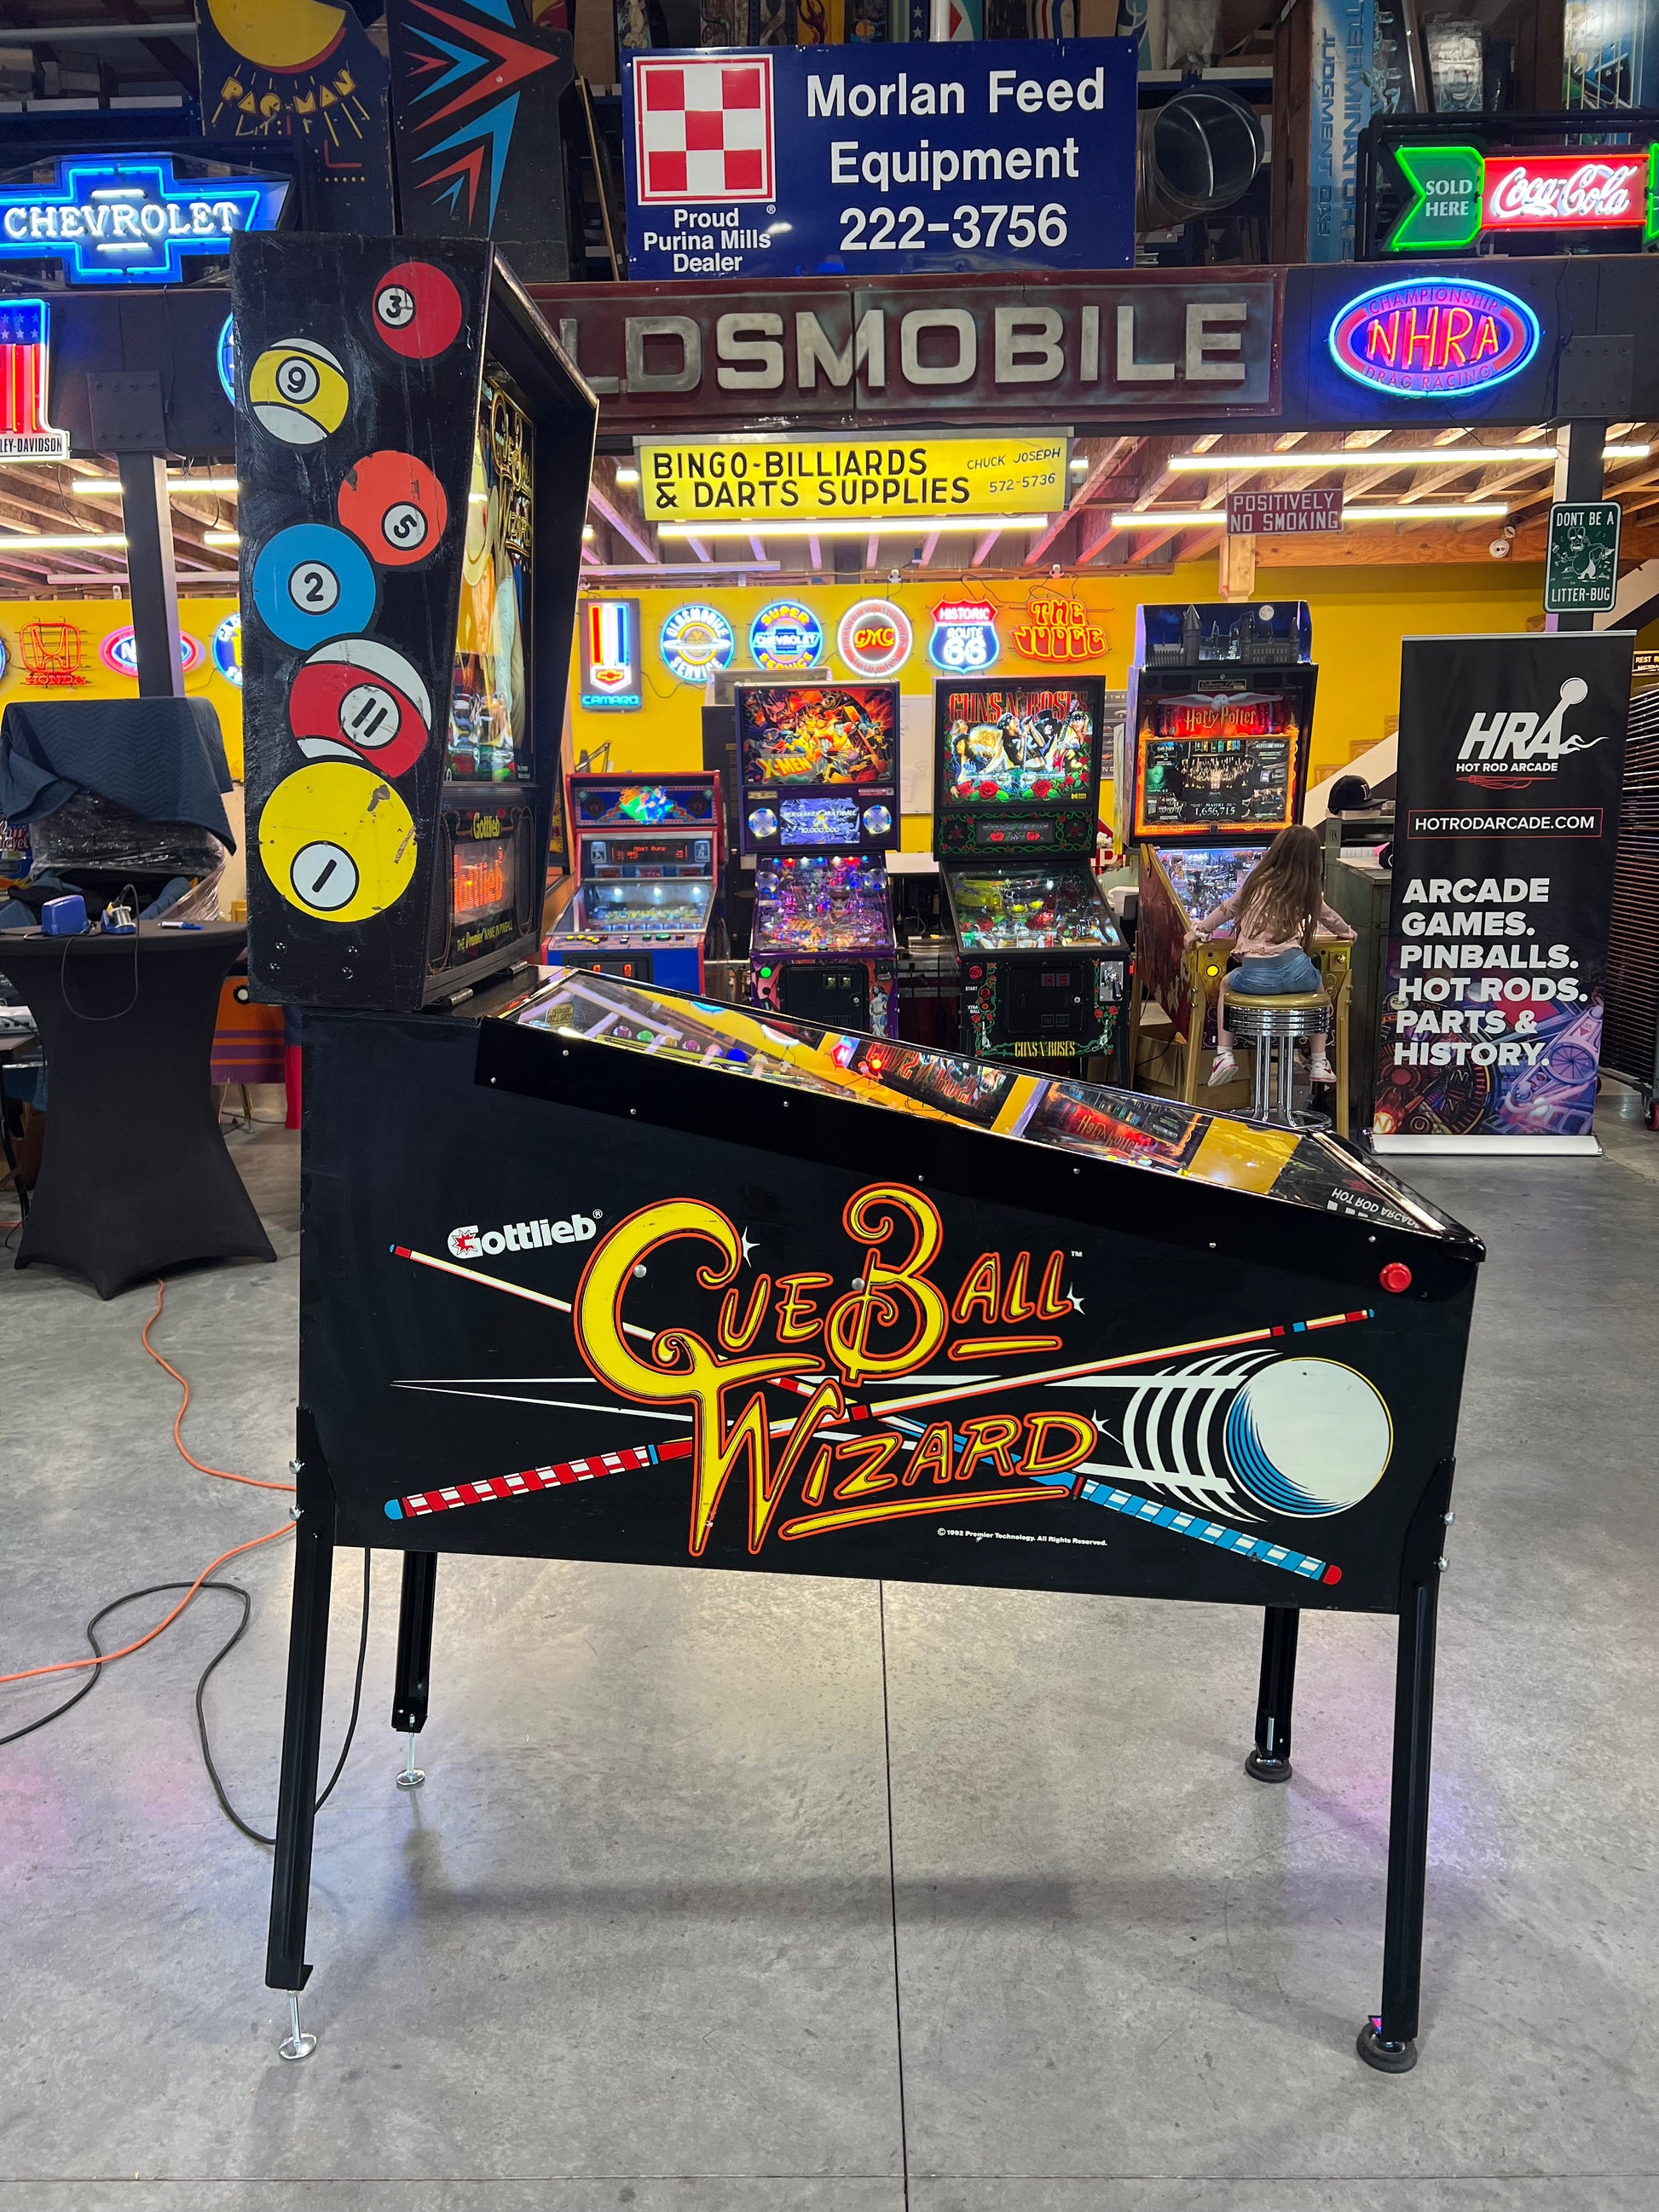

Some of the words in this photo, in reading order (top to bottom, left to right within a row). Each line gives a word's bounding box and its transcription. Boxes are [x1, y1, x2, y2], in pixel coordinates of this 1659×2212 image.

[806, 73, 965, 118] Morlan
[989, 66, 1106, 113] Feed
[1321, 27, 1336, 177] JUDGMENT
[830, 136, 1080, 192] Equipment
[1425, 180, 1472, 195] SOLD
[1491, 165, 1638, 217] Coca-Cola
[3, 201, 240, 239] CHEVROLET
[673, 208, 740, 228] Proud
[1317, 183, 1332, 237] DAY
[1425, 201, 1468, 217] HERE
[839, 203, 1069, 251] 222-3756
[643, 231, 714, 252] Purina
[720, 229, 772, 250] Mills
[673, 251, 743, 273] Dealer
[385, 295, 402, 320] 3
[1368, 288, 1499, 315] CHAMPIONSHIP
[559, 303, 1247, 395] LDSMOBILE
[1367, 307, 1499, 371] NHRA
[286, 360, 305, 391] 9
[1365, 367, 1413, 390] DRAG
[1422, 365, 1491, 390] RACING
[653, 448, 928, 479] BINGO-BILLIARDS
[967, 453, 1006, 470] CHUCK
[1012, 448, 1061, 467] JOSEPH
[656, 486, 679, 509] &
[695, 480, 799, 508] DARTS
[820, 477, 970, 505] SUPPLIES
[989, 473, 1055, 494] 572-5736
[1233, 492, 1335, 512] POSITIVELY
[394, 516, 417, 538] 5
[1230, 515, 1255, 532] NO
[1262, 511, 1338, 531] SMOKING
[1589, 512, 1602, 525] BE
[1607, 511, 1615, 525] A
[304, 572, 324, 602] 2
[1552, 587, 1610, 603] LITTER-BUG
[666, 607, 729, 637] OLDSMOBILE
[760, 605, 810, 626] SUPER
[939, 606, 991, 621] HISTORIC
[1031, 599, 1087, 627] THE
[755, 634, 818, 646] CHEVROLET
[854, 627, 895, 649] GMC
[946, 626, 985, 639] ROUTE
[1013, 626, 1107, 658] JUDGE
[943, 638, 987, 665] 66
[1635, 656, 1651, 664] REST
[25, 675, 86, 686] HONDA
[581, 695, 640, 706] CAMARO
[950, 691, 1003, 724] GUNS
[1026, 690, 1089, 723] ROSES
[350, 696, 388, 737] 11
[1183, 708, 1219, 732] Harry
[1221, 705, 1257, 730] Potter
[1457, 711, 1562, 760] HRA
[757, 757, 812, 781] X-MEN
[1456, 763, 1480, 772] HOT
[1483, 762, 1508, 772] ROD
[1510, 762, 1558, 772] ARCADE
[1194, 806, 1236, 817] 1,656,715
[1414, 815, 1595, 832] HOTRODARCADE.COM
[472, 812, 500, 840] Gottlieb
[1402, 878, 1550, 904] ARCADE
[1401, 911, 1535, 937] GAMES.
[1399, 944, 1579, 969] PINBALLS.
[1398, 977, 1471, 1002] HOT
[1480, 977, 1587, 1002] RODS.
[1396, 1010, 1506, 1034] PARTS
[1515, 1009, 1537, 1034] &
[1014, 1041, 1038, 1057] GUNS
[1048, 1041, 1075, 1057] ROSES
[1394, 1042, 1550, 1066] HISTORY.
[574, 1198, 834, 1405] CUE
[824, 1182, 1072, 1388] BALL
[689, 1355, 1097, 1556] WIZARD
[995, 1533, 1035, 1542] Technology.
[1072, 1538, 1107, 1546] Reserved.
